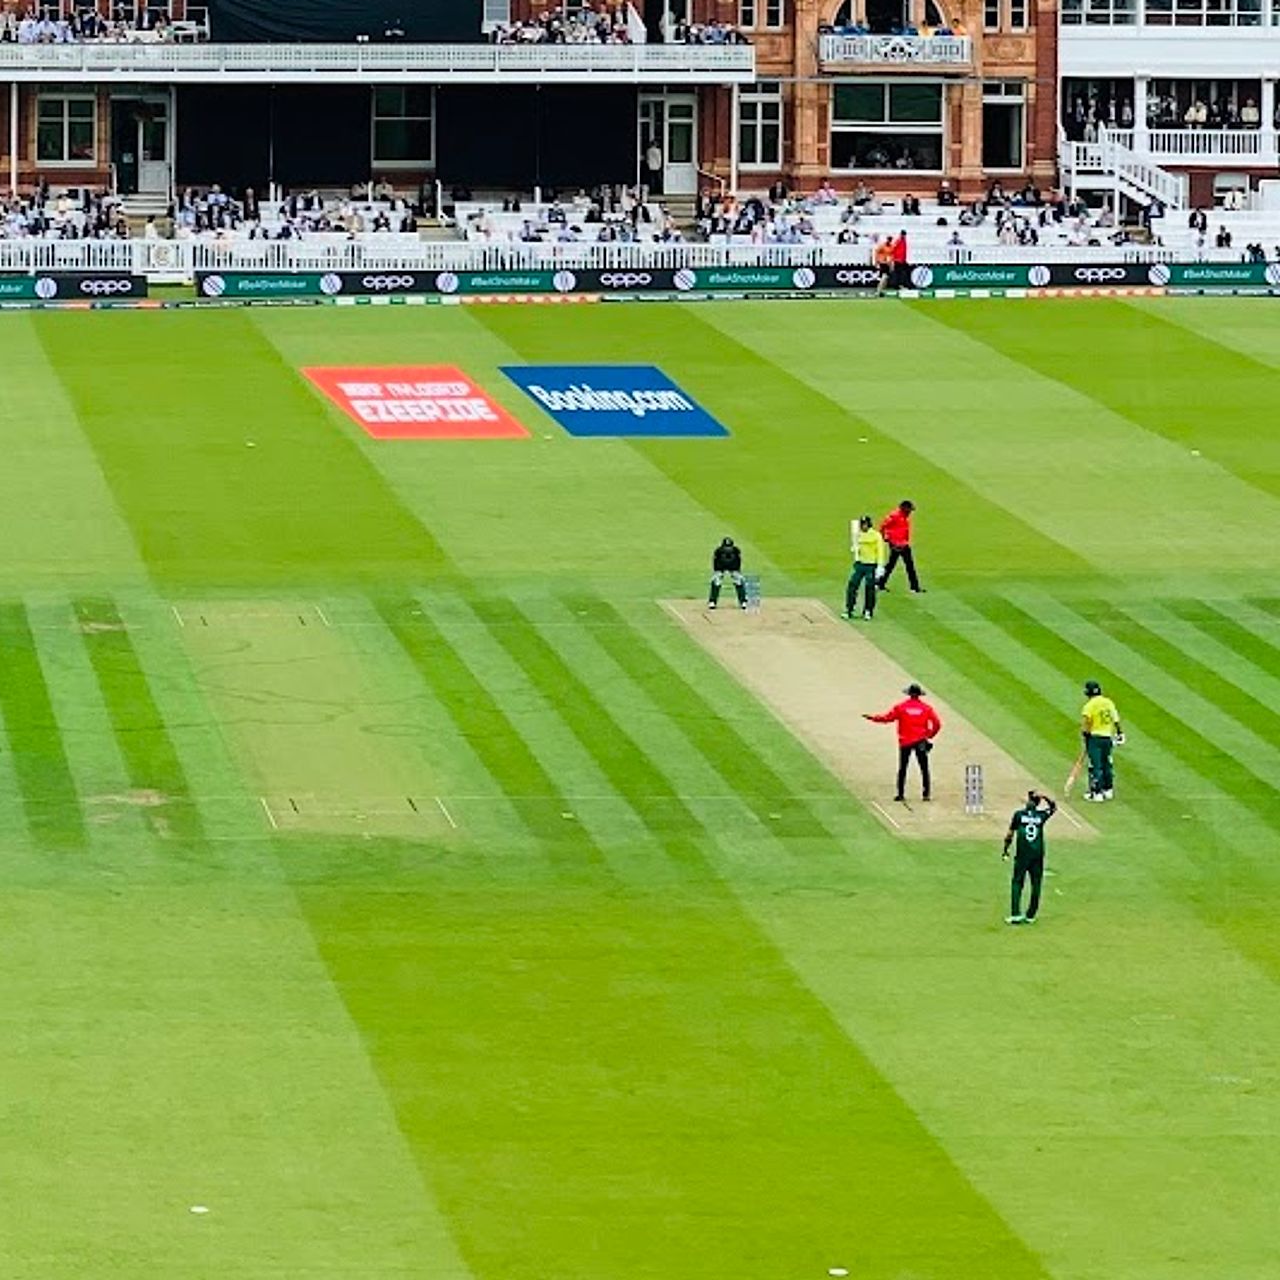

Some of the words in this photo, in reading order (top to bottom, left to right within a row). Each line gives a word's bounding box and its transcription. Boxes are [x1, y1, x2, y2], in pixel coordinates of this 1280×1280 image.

[362, 275, 414, 291] oppo
[600, 272, 652, 287] oppo
[1073, 268, 1126, 283] oppo
[80, 279, 132, 295] oppo
[527, 383, 695, 418] Booking.com
[1025, 824, 1037, 841] 9
